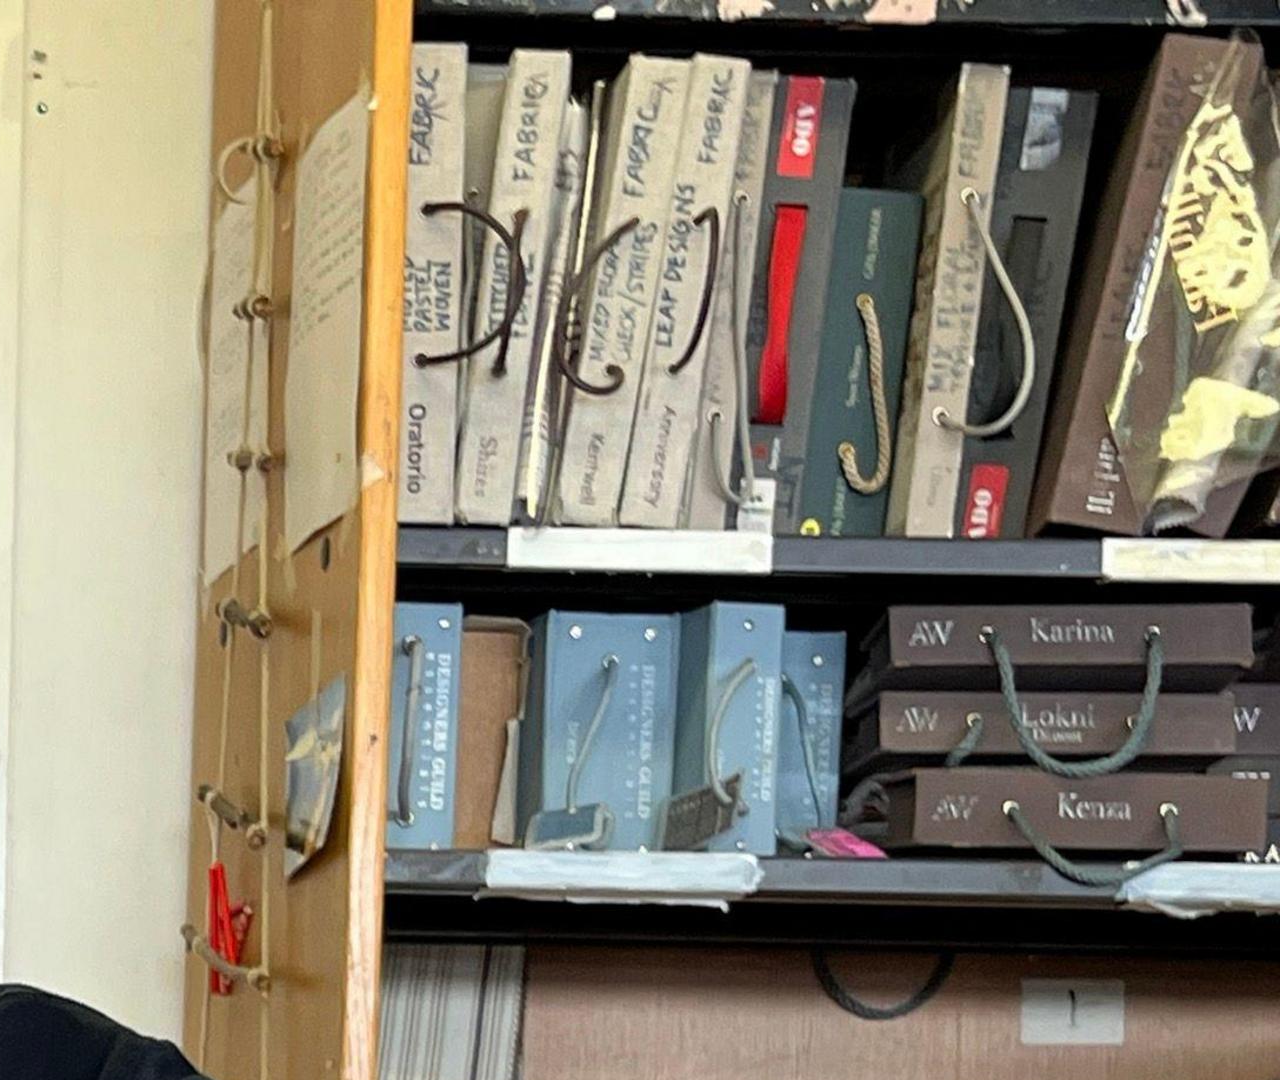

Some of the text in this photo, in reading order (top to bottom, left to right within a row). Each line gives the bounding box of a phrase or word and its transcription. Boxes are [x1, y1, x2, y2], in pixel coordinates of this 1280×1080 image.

[790, 104, 815, 157] ADO
[413, 259, 432, 333] PASTEL
[434, 261, 451, 332] WOVEN
[655, 182, 696, 349] LEAF DESIGNS
[407, 403, 427, 494] Oratorio
[968, 489, 993, 538] ADO
[908, 617, 1116, 648] AW Karina
[429, 652, 452, 812] DESIGNERS GUILD
[637, 664, 657, 820] DESIGNERS GUILD
[762, 677, 777, 757] DESIGNERS
[896, 707, 939, 733] AW
[1057, 791, 1133, 822] Kenza
